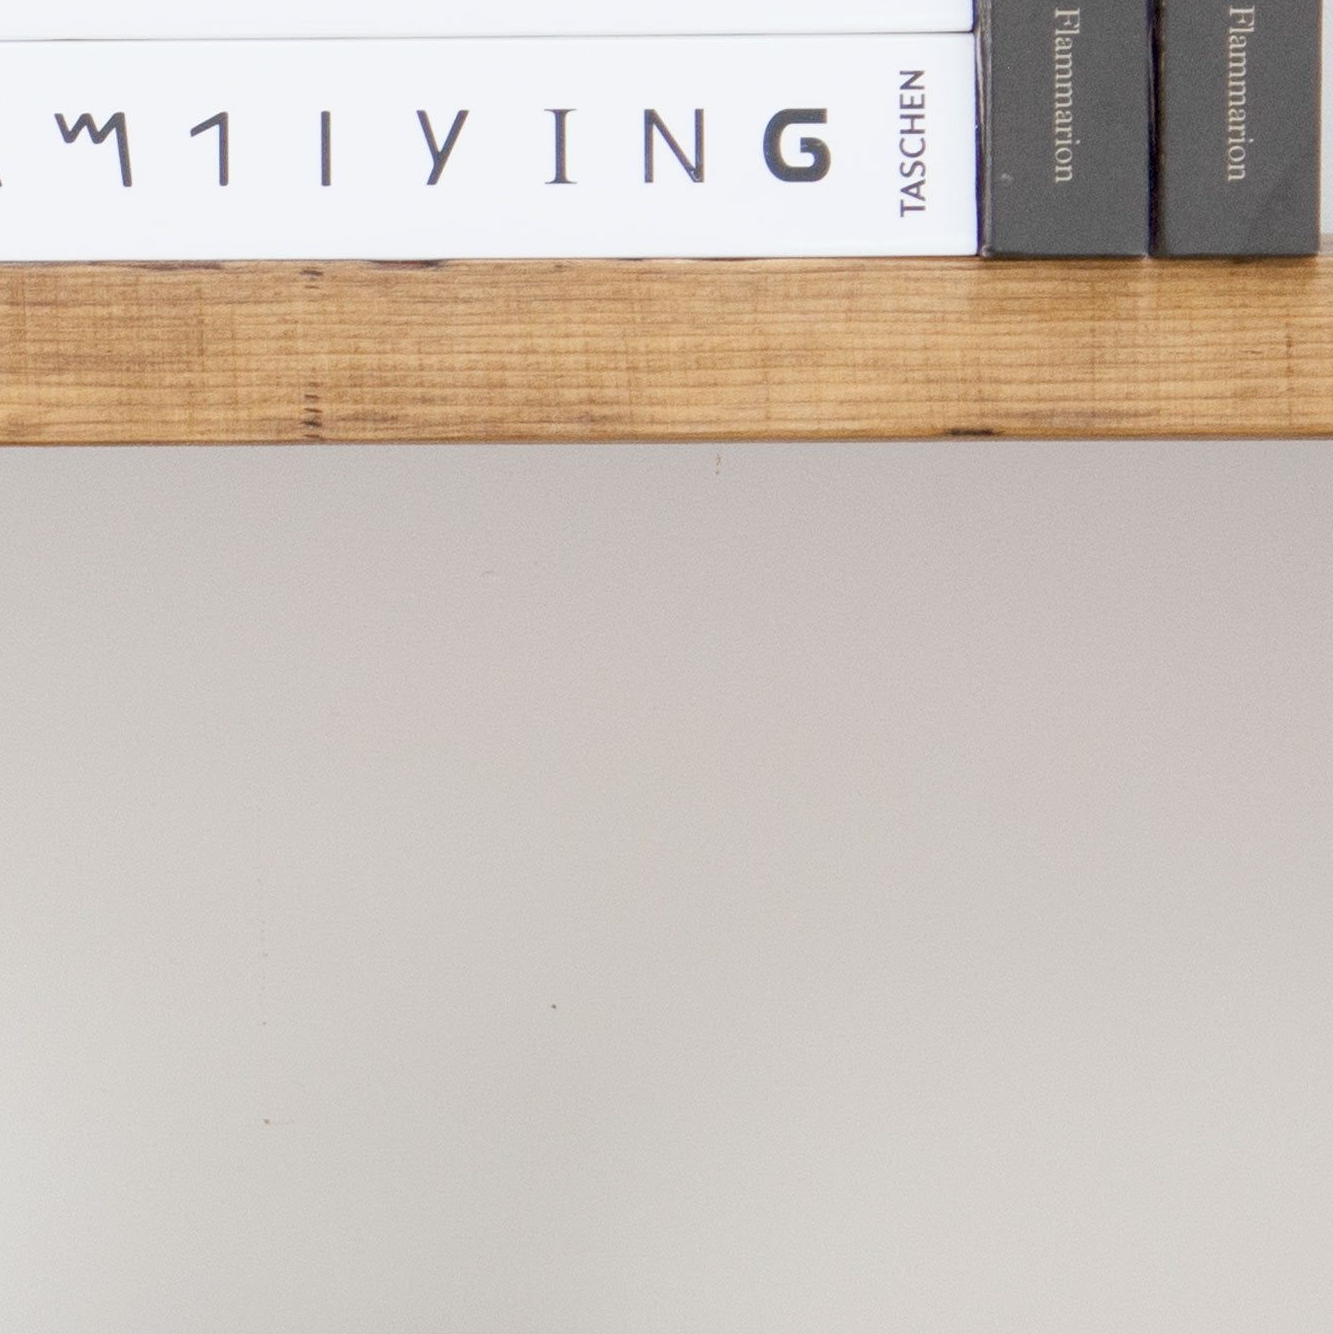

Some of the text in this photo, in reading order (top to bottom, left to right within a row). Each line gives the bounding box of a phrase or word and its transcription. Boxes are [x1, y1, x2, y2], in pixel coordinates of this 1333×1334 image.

[897, 69, 927, 219] TASCHEN
[1054, 6, 1081, 185] Flammarion
[1227, 4, 1255, 183] Flammarion
